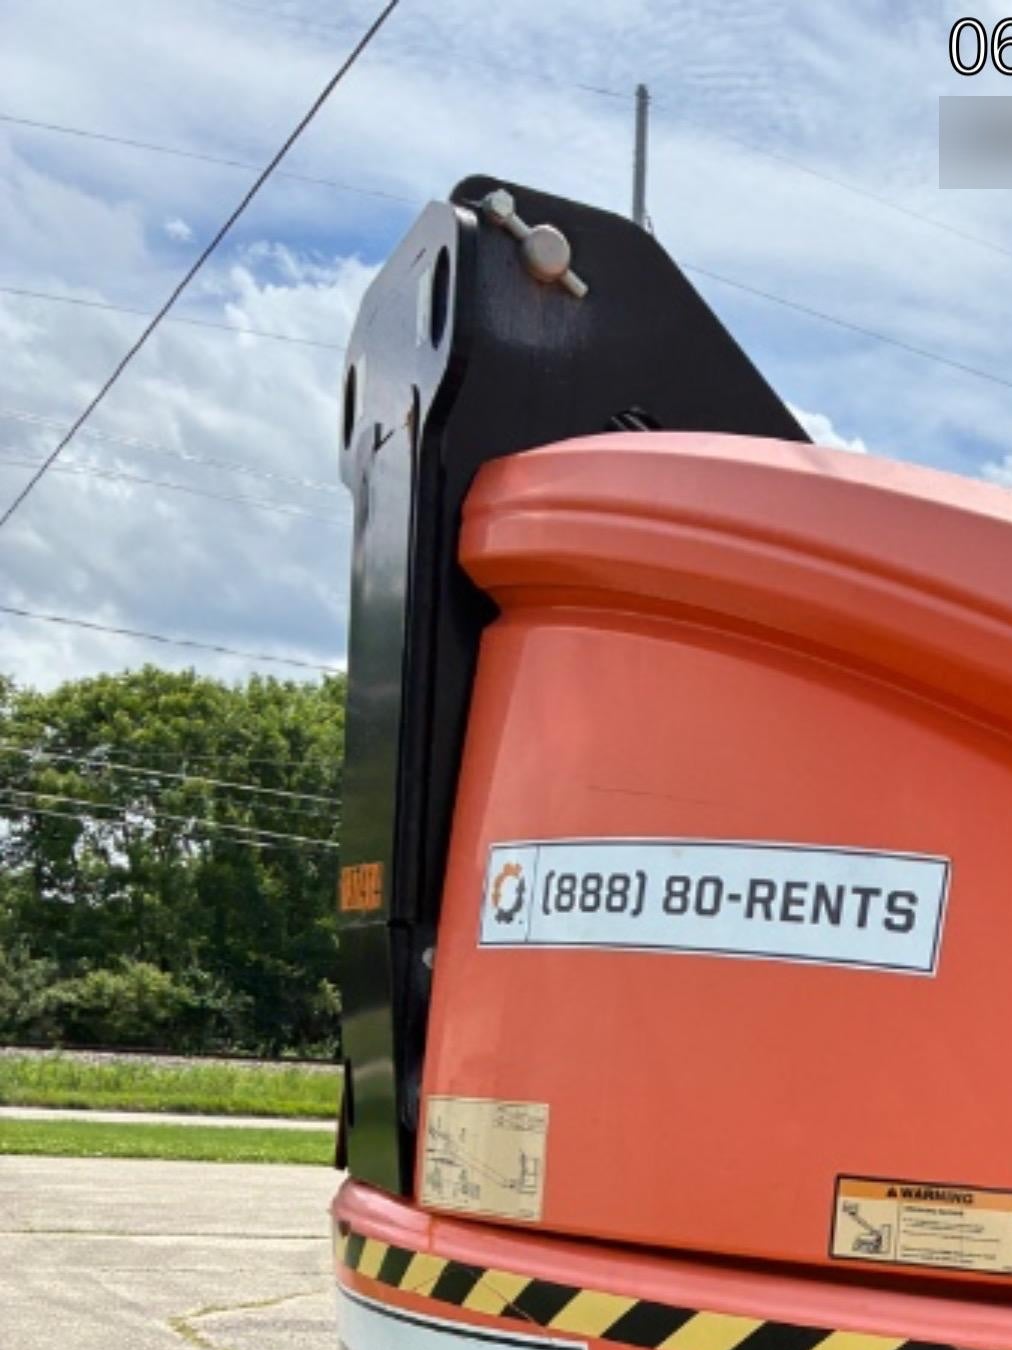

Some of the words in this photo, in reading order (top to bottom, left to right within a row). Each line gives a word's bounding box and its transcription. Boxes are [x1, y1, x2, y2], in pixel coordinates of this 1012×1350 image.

[542, 870, 648, 918] (888)
[662, 875, 920, 934] 80-RENTS
[901, 1187, 974, 1205] WARNING
